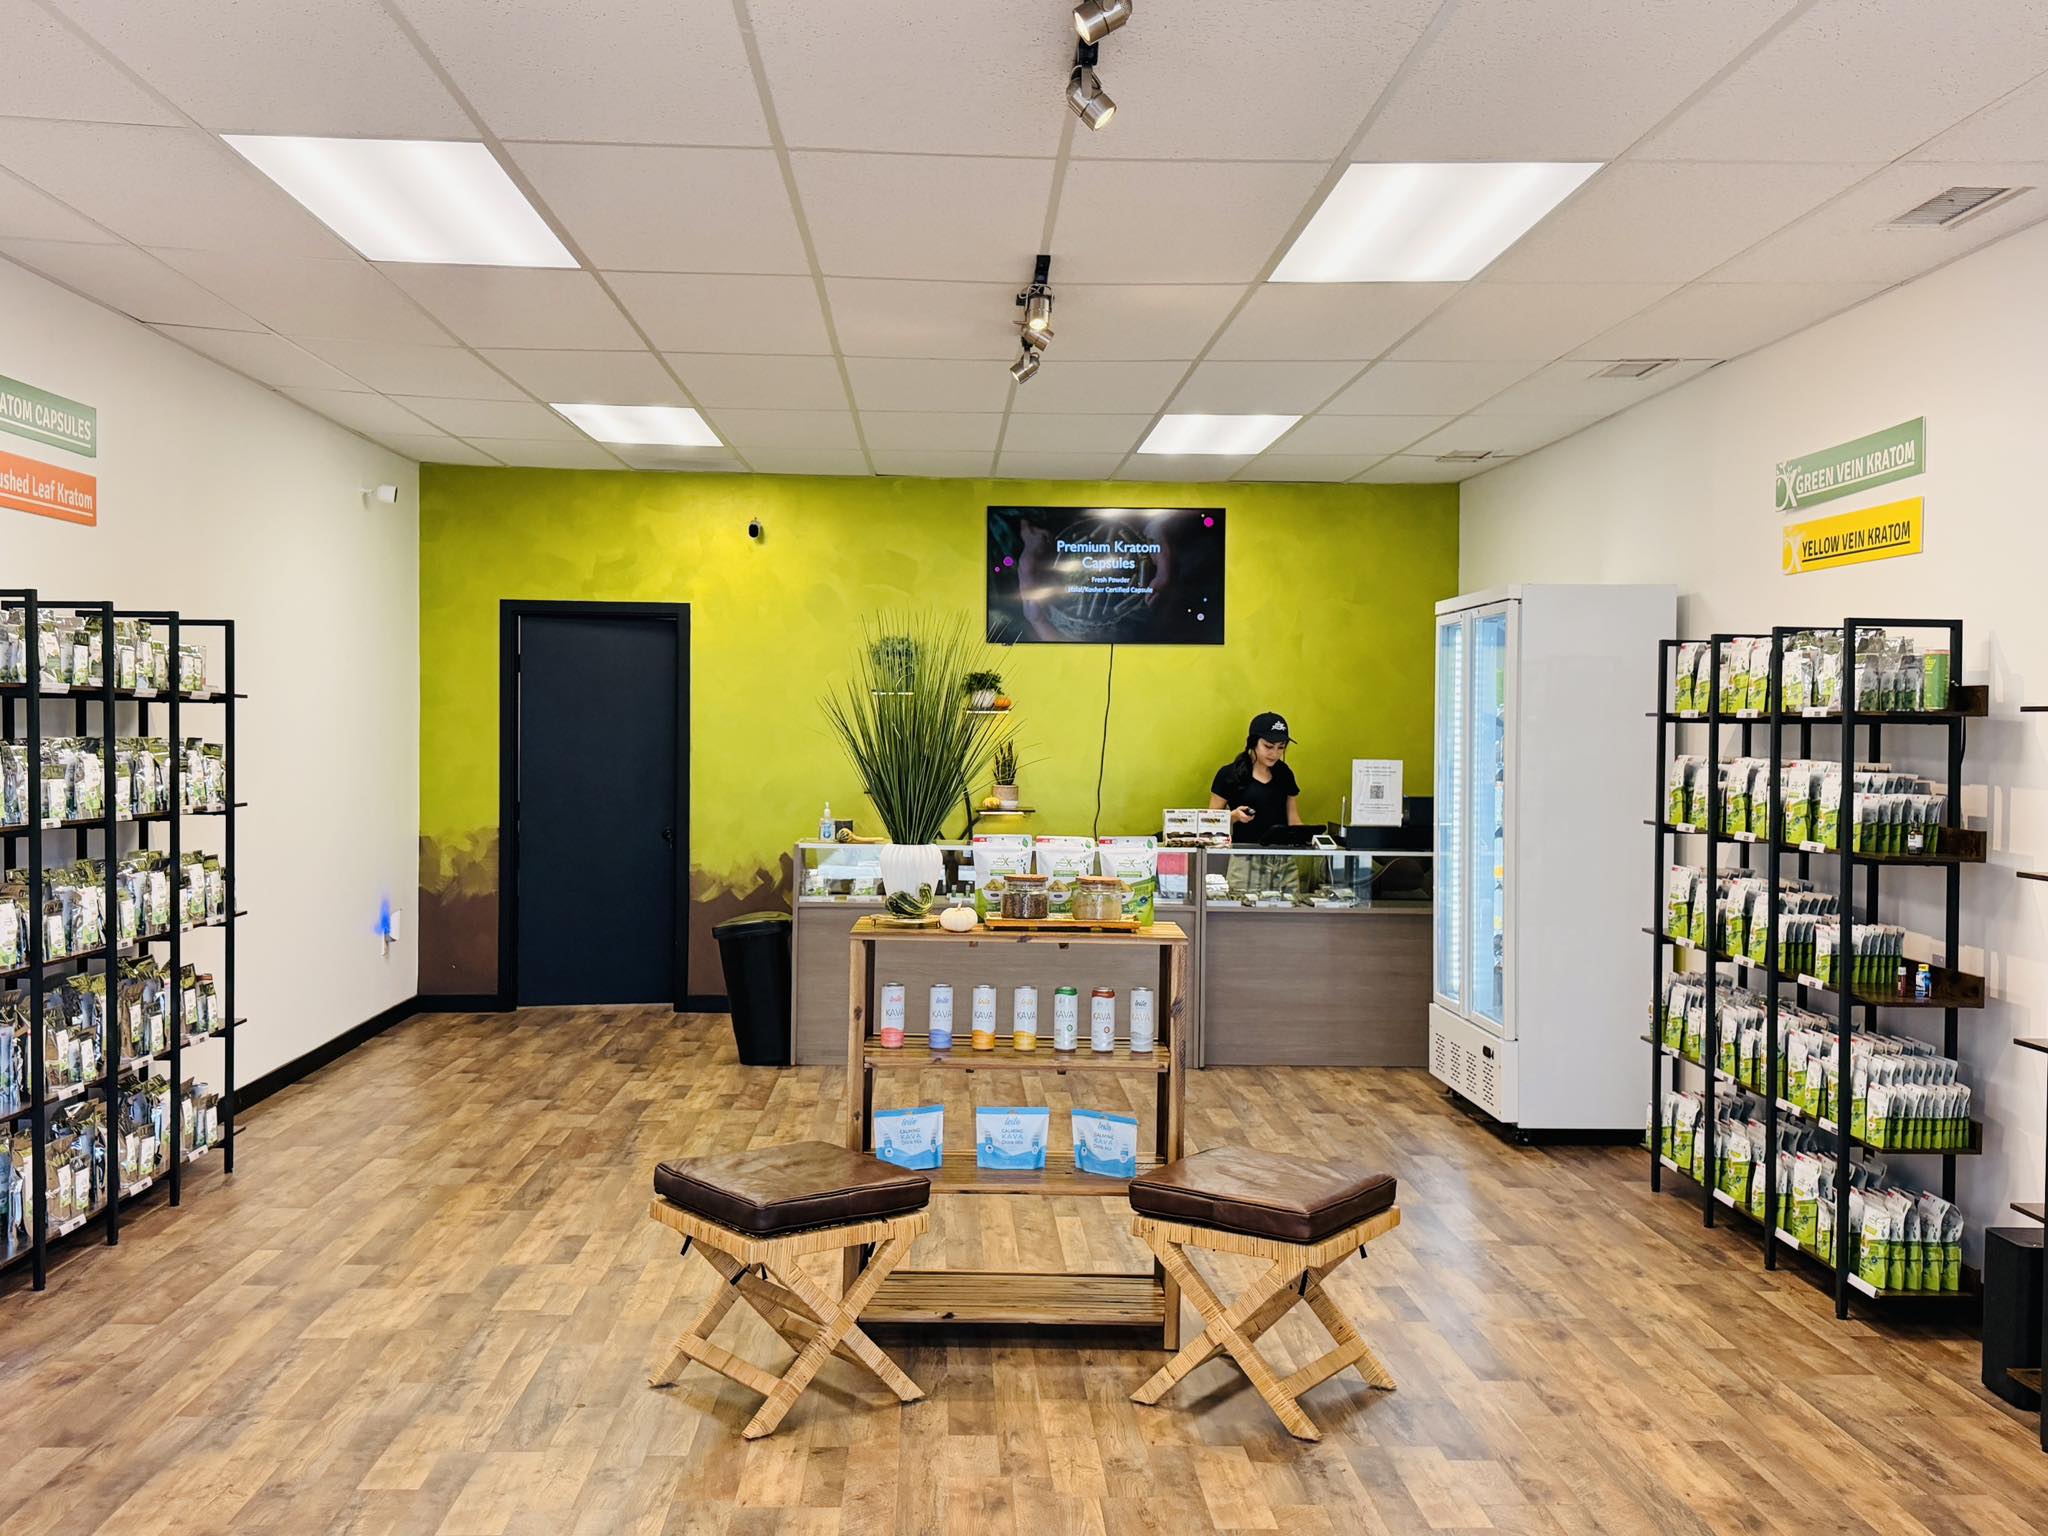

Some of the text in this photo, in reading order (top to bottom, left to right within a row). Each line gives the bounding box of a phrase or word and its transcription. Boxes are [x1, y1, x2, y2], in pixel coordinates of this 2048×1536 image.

[35, 404, 91, 441] CAPSULES
[1796, 440, 1915, 494] GREEN VEIN KRATOM
[32, 475, 56, 502] Leaf
[57, 481, 93, 510] Kratom
[1802, 520, 1911, 557] YELLOW VEIN KRATOM
[1056, 540, 1161, 553] Premium Kratom
[1082, 556, 1136, 572] Capsules
[1131, 586, 1153, 594] Capsule
[886, 1008, 905, 1017] KAVA
[932, 1009, 952, 1018] KAVA
[974, 1010, 993, 1019] KAVA
[1016, 1011, 1036, 1020] KAVA
[1056, 1010, 1074, 1018] KAVA
[1093, 1012, 1111, 1020] KAVA
